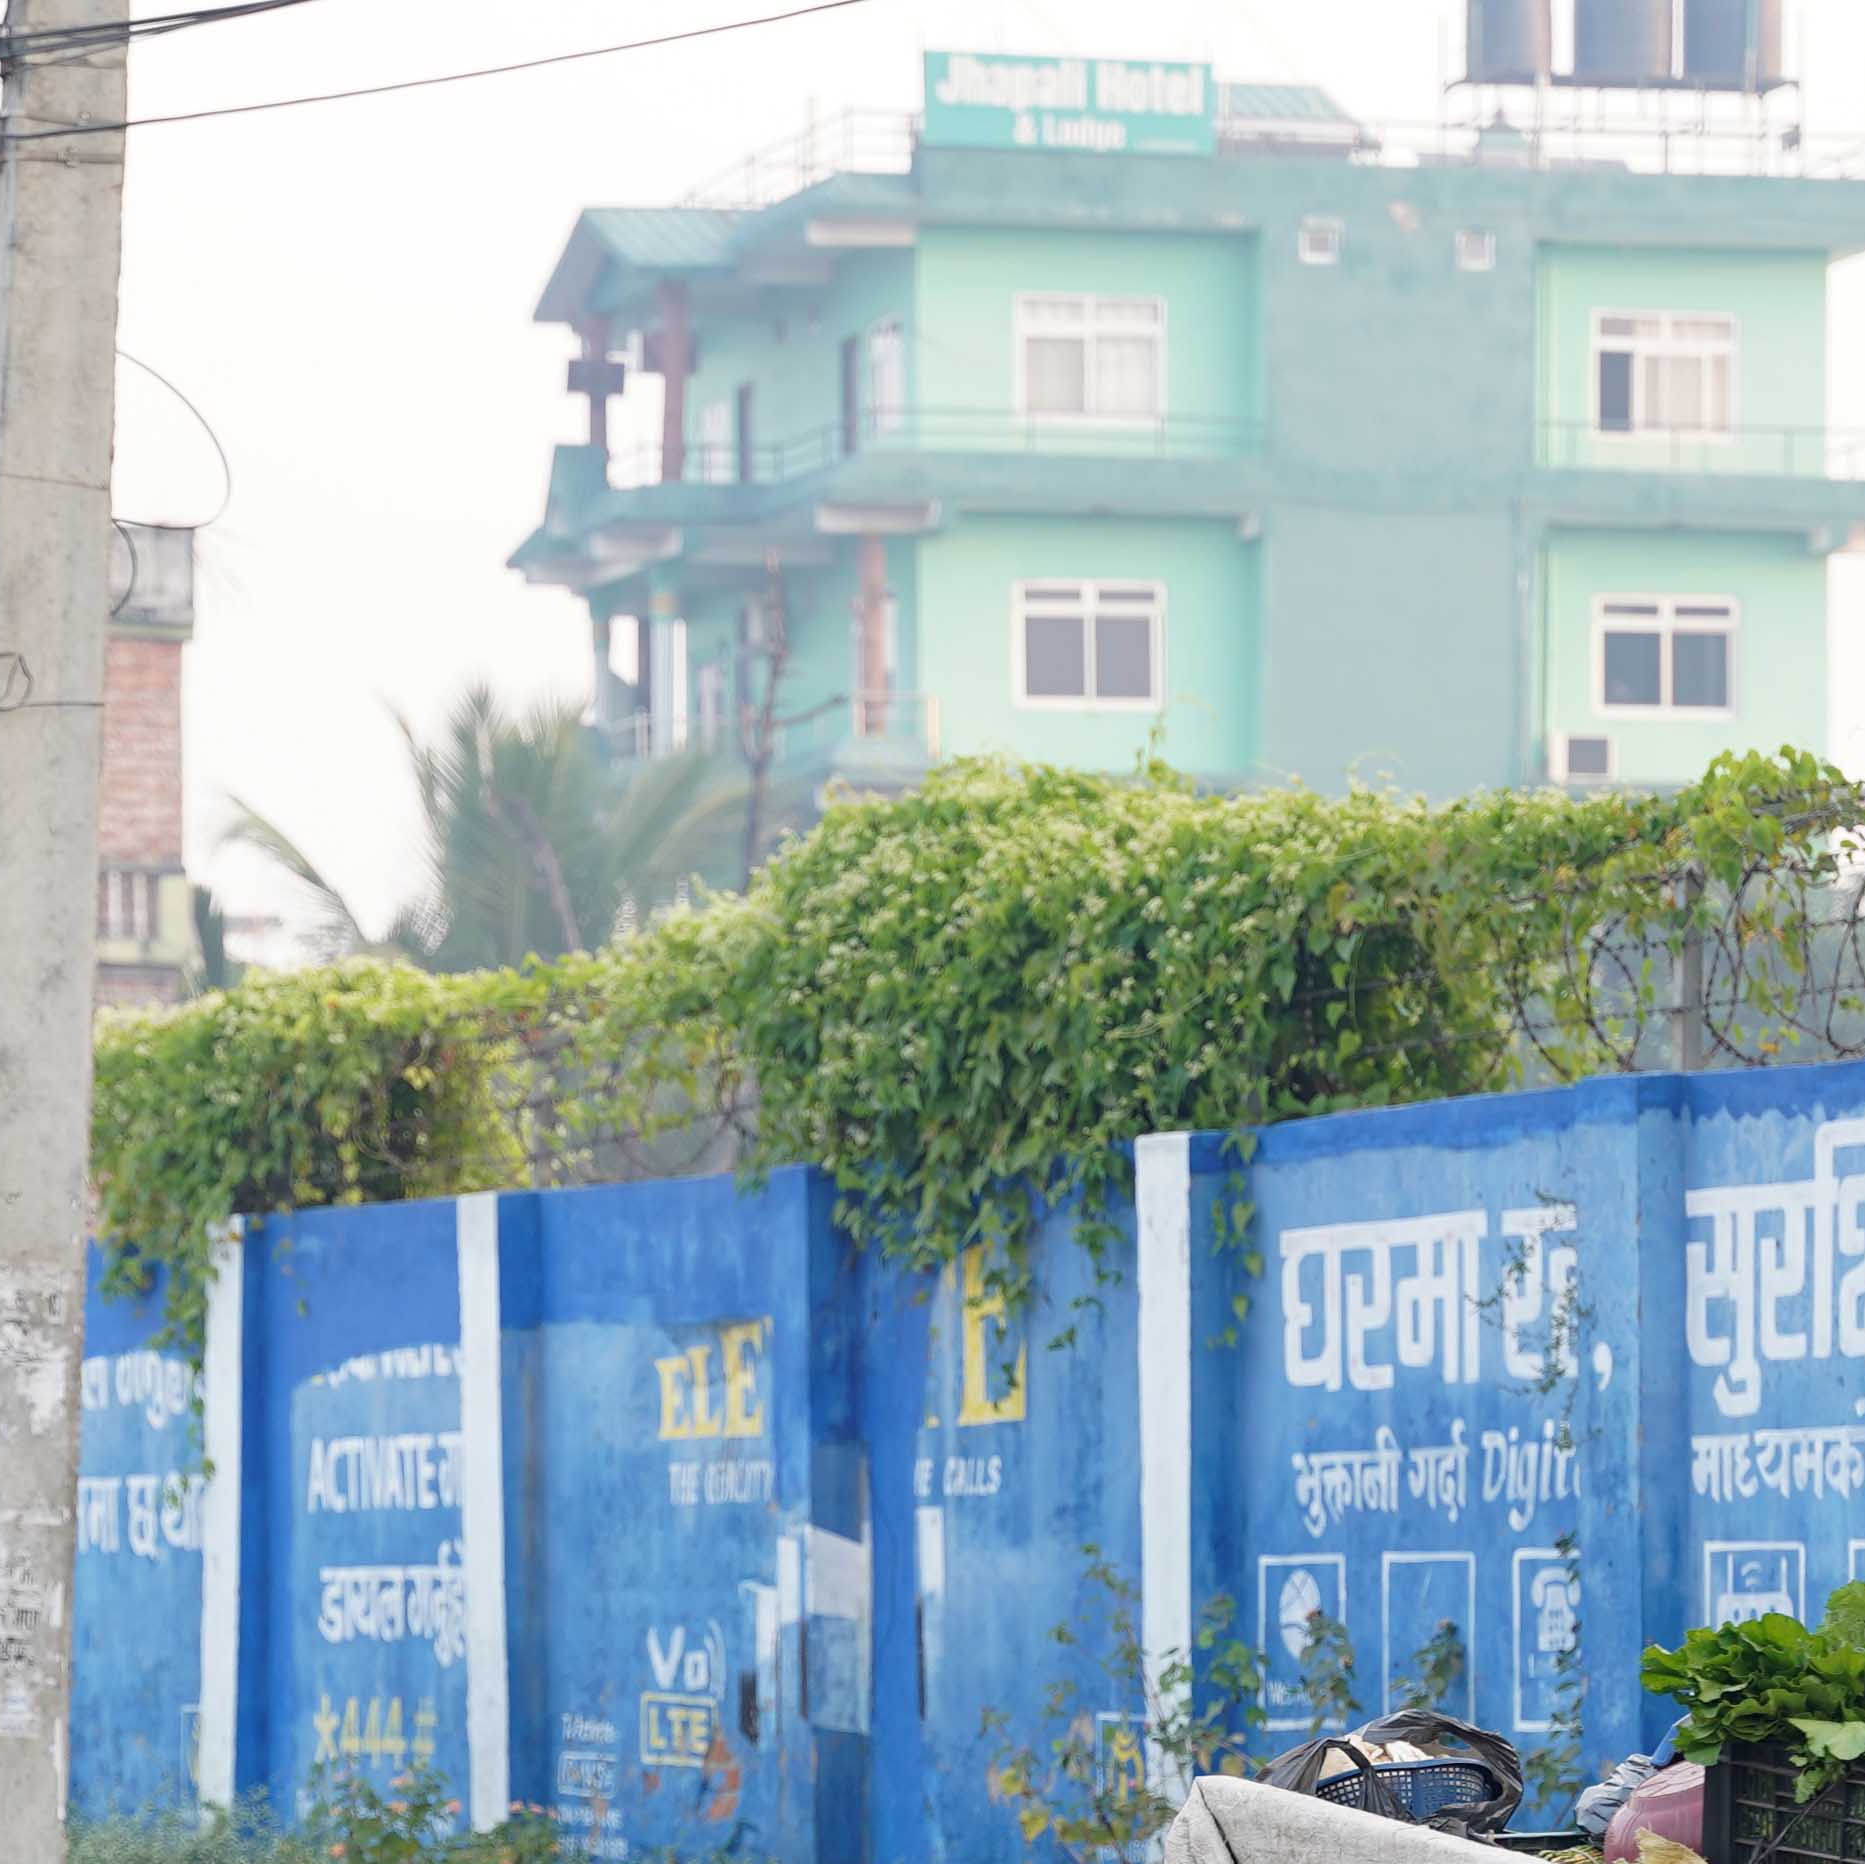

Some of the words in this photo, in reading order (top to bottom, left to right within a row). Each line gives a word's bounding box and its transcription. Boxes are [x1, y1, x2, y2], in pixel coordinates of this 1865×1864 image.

[1094, 60, 1205, 116] Hotel
[1279, 1209, 1488, 1392] घरमा
[308, 1432, 436, 1514] ACTIVATE
[944, 1454, 1002, 1496] CALLS
[1408, 1418, 1470, 1522] गर्दा
[1482, 1419, 1581, 1532] Digit
[647, 1706, 709, 1753] LTE
